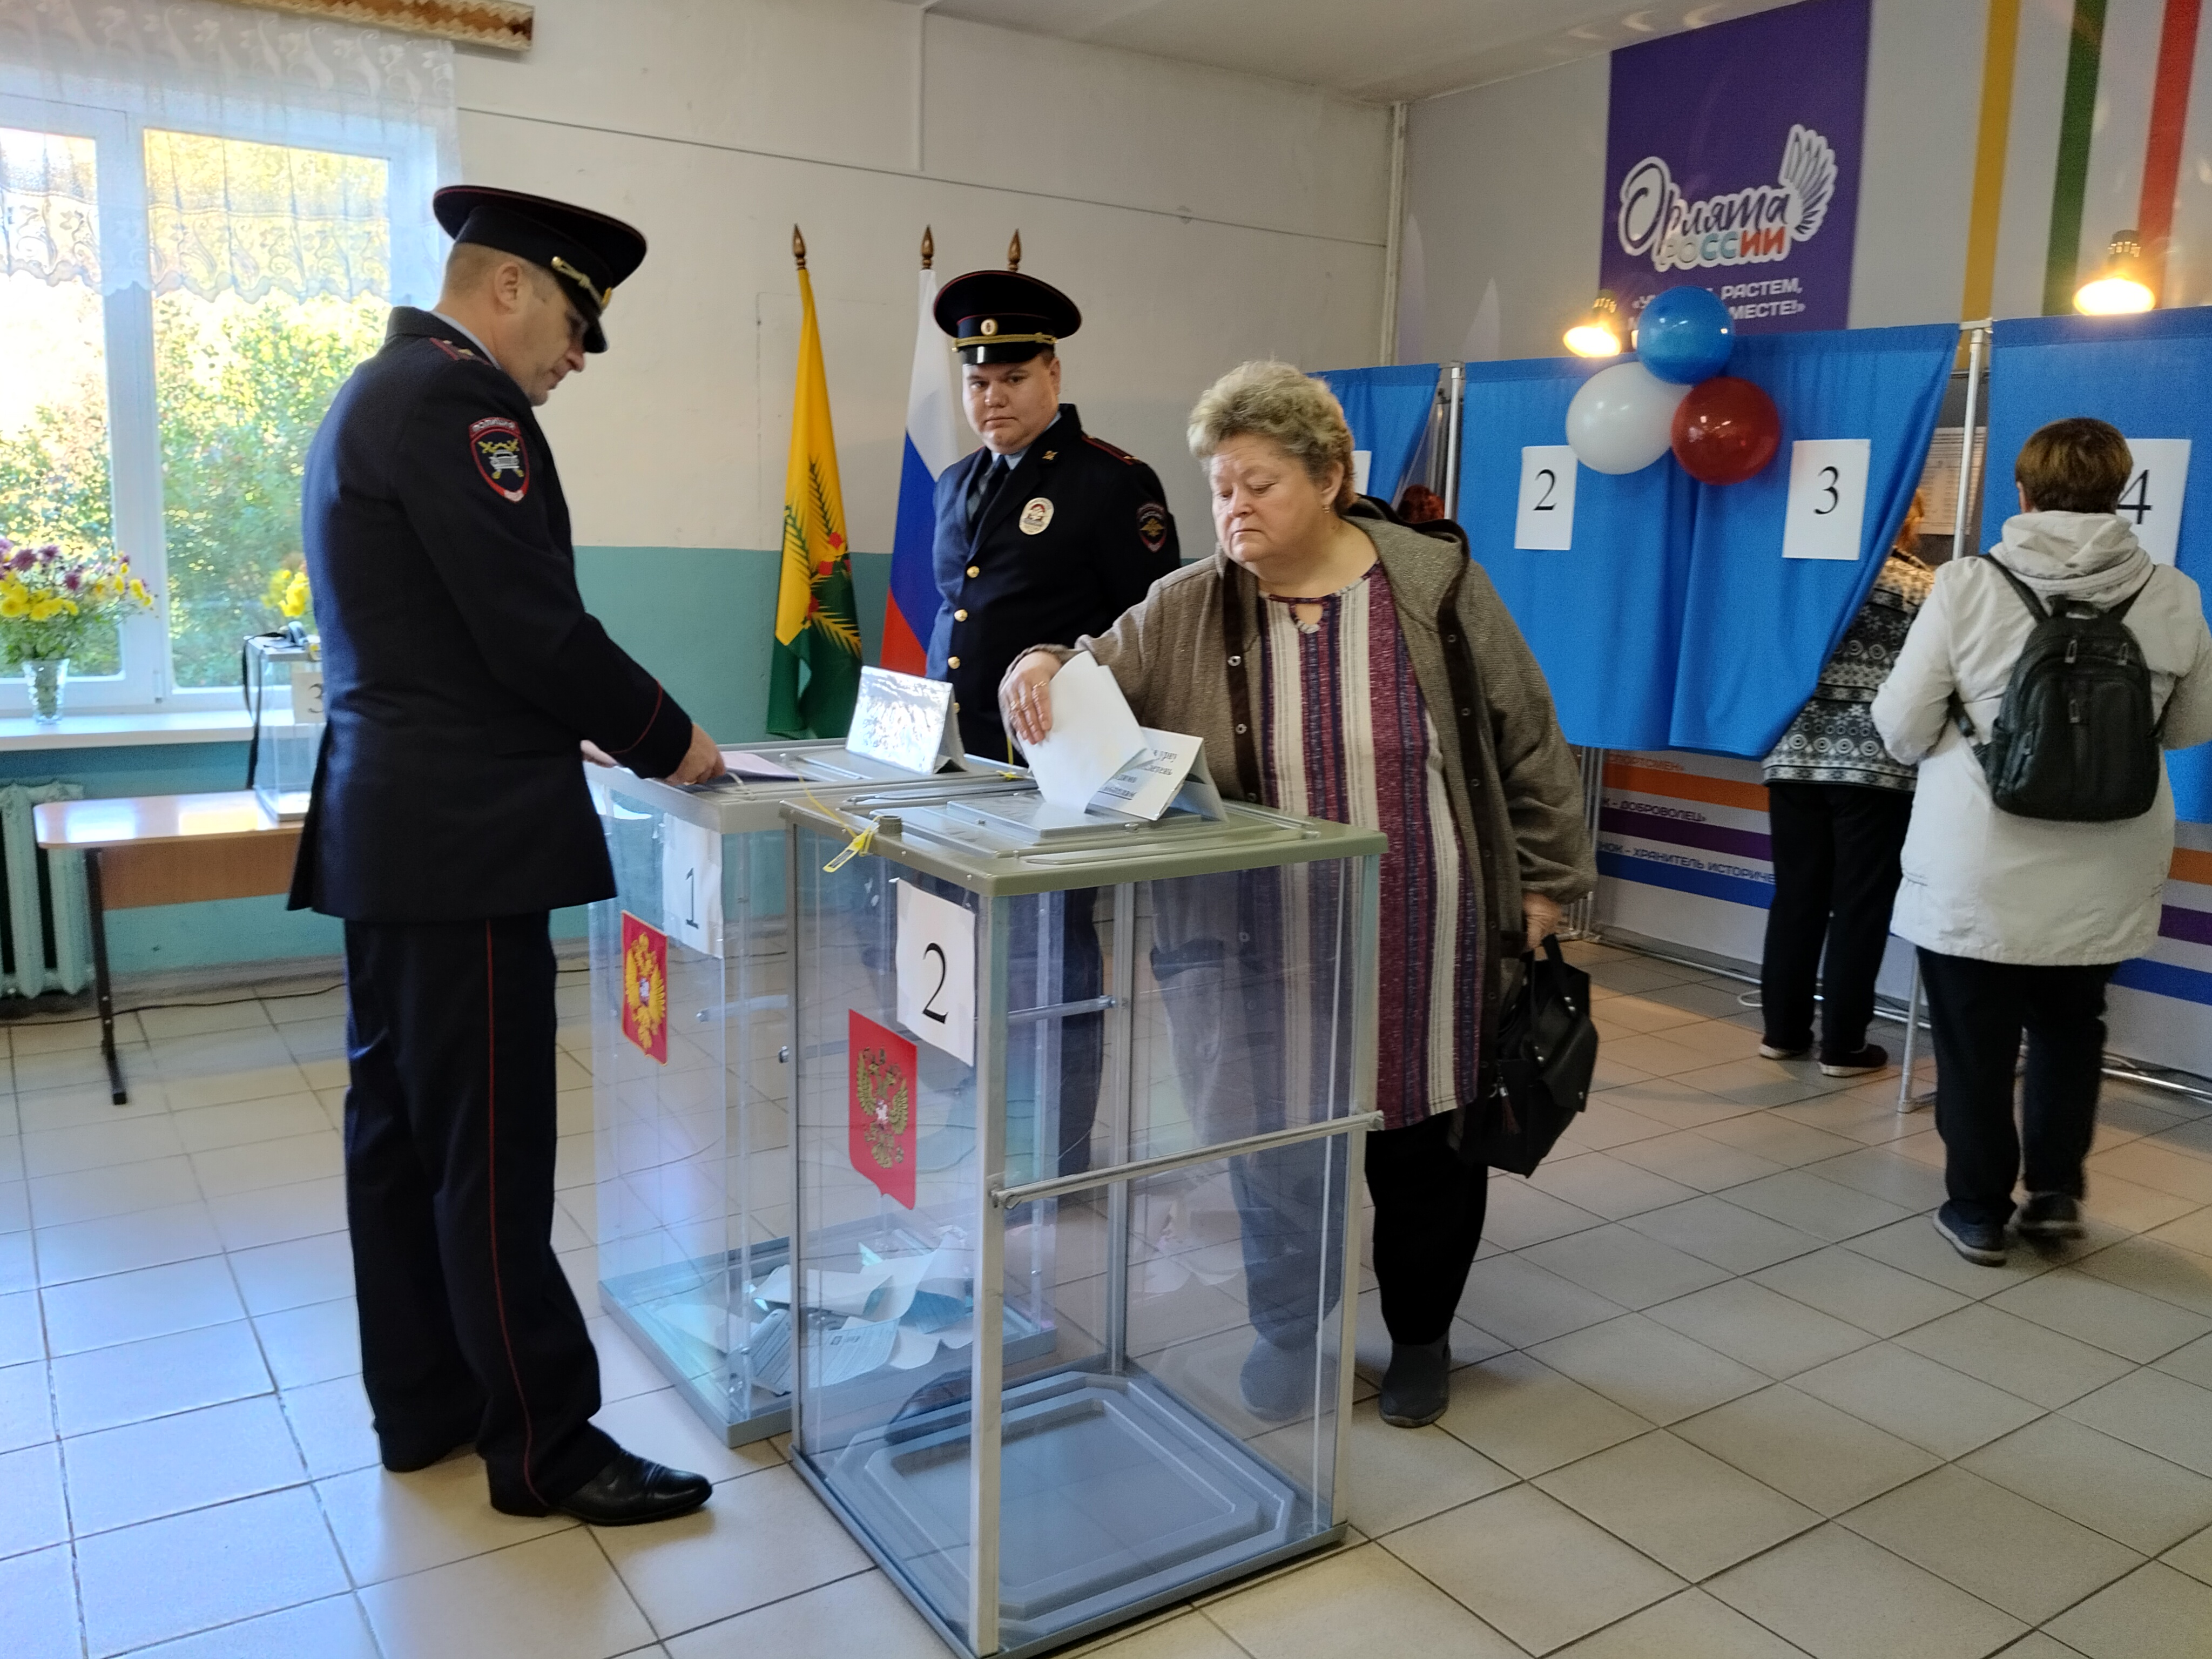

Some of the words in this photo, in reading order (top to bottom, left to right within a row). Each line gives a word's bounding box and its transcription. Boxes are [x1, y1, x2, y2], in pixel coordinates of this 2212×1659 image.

[1624, 163, 1791, 257] Орлята
[1721, 278, 1803, 300] РАСТЕМ,
[1729, 300, 1806, 320] МЕСТЕ!»
[1533, 469, 1557, 511] 2
[1813, 466, 1839, 515] 3
[2117, 469, 2153, 525] 4
[307, 683, 324, 713] 3
[1633, 848, 1704, 869] ХРАНИТЕЛЬ
[685, 867, 699, 929] 1
[922, 942, 949, 1024] 2
